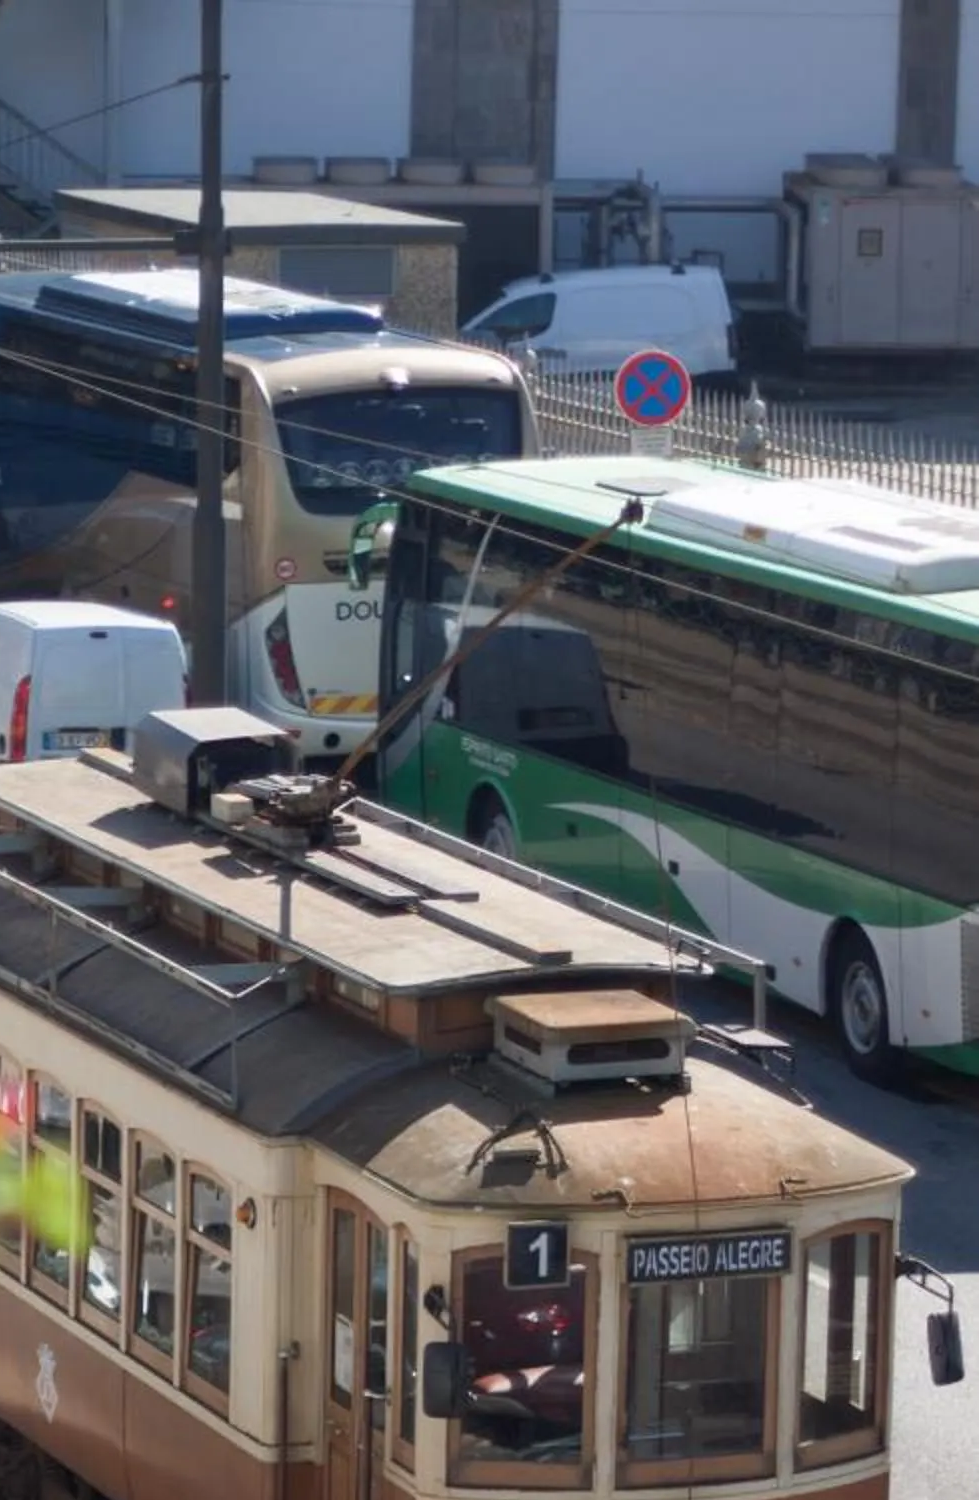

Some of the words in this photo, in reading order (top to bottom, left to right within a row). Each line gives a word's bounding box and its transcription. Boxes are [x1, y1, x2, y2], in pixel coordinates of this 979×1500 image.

[529, 1231, 550, 1278] 1
[633, 1244, 708, 1277] PASSEIO
[714, 1238, 784, 1271] ALEGRE
